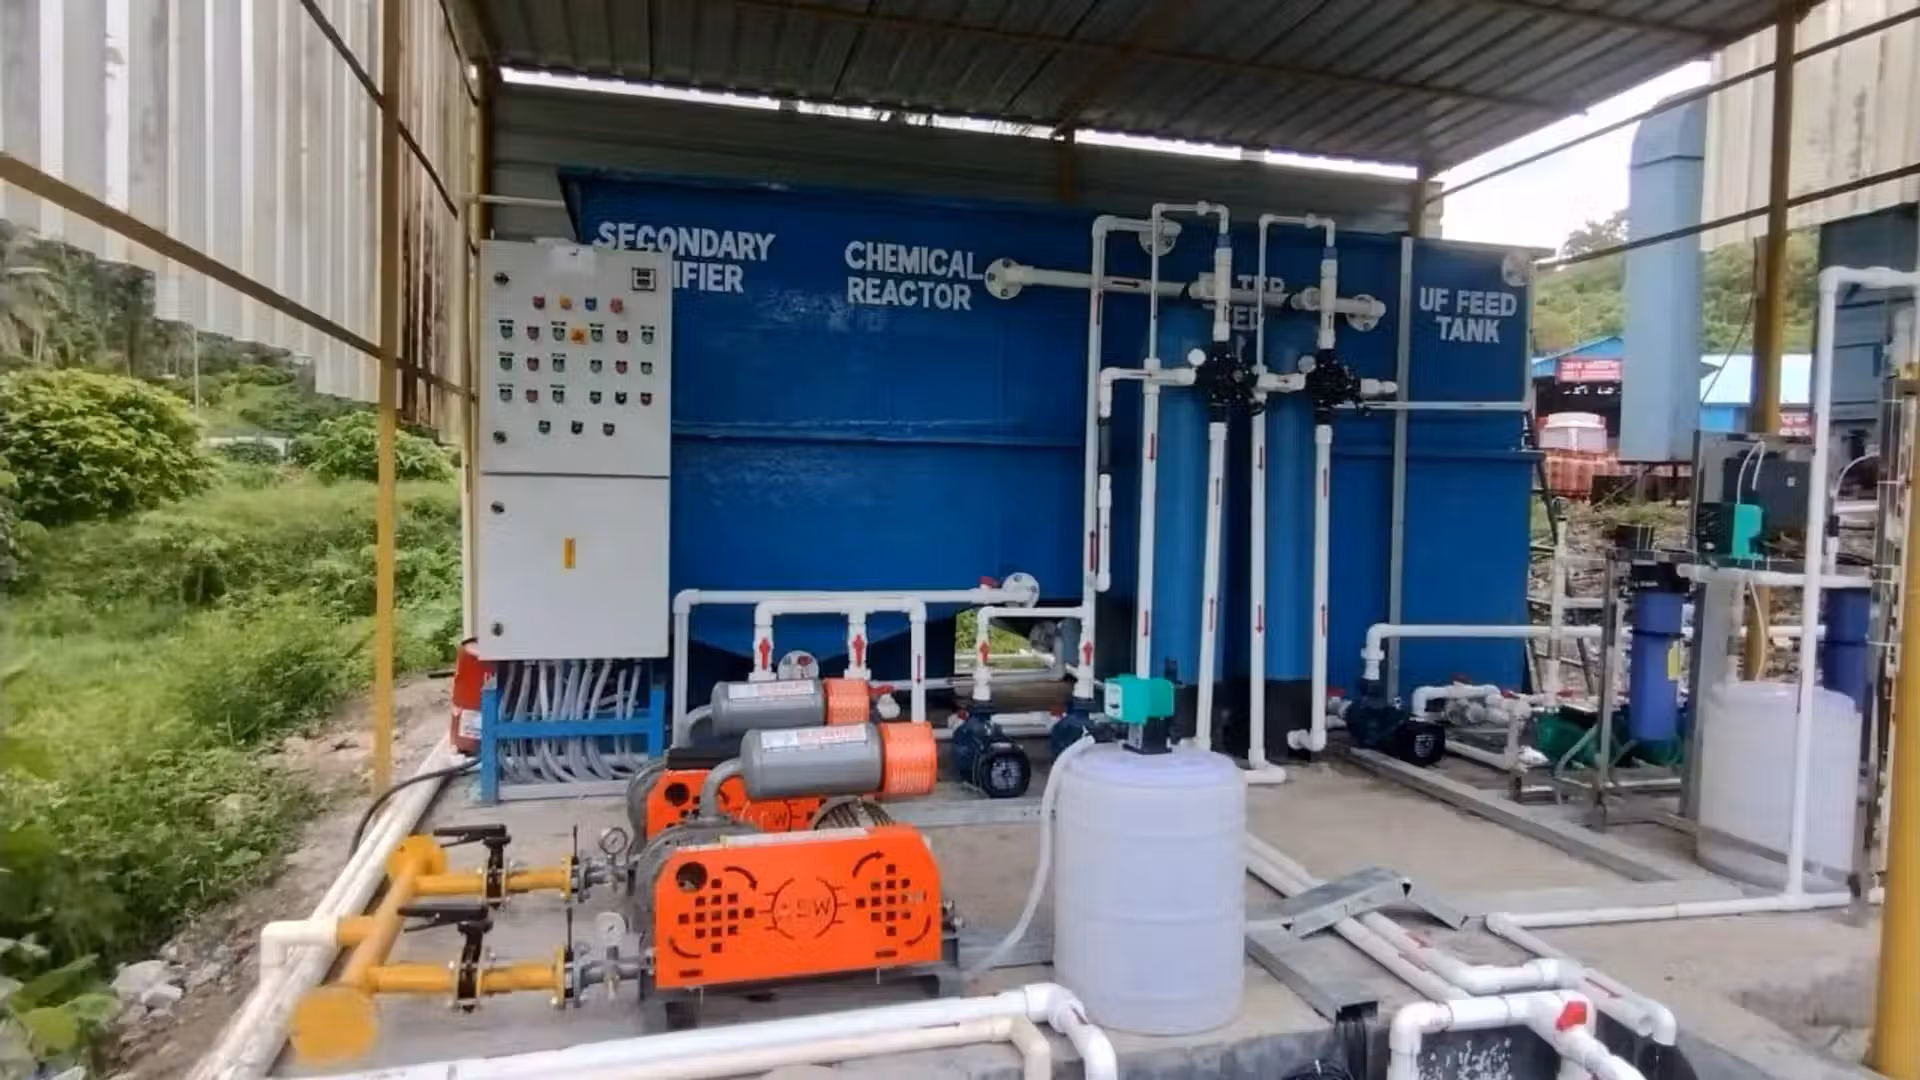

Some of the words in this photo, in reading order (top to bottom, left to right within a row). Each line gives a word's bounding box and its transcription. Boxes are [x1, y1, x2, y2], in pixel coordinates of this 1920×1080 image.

[592, 221, 777, 262] SECONDARY
[844, 240, 985, 281] CHEMICAL
[847, 276, 972, 312] REACTOR
[1419, 286, 1449, 313] UF
[1456, 289, 1518, 317] FEED
[1435, 315, 1501, 344] TANK
